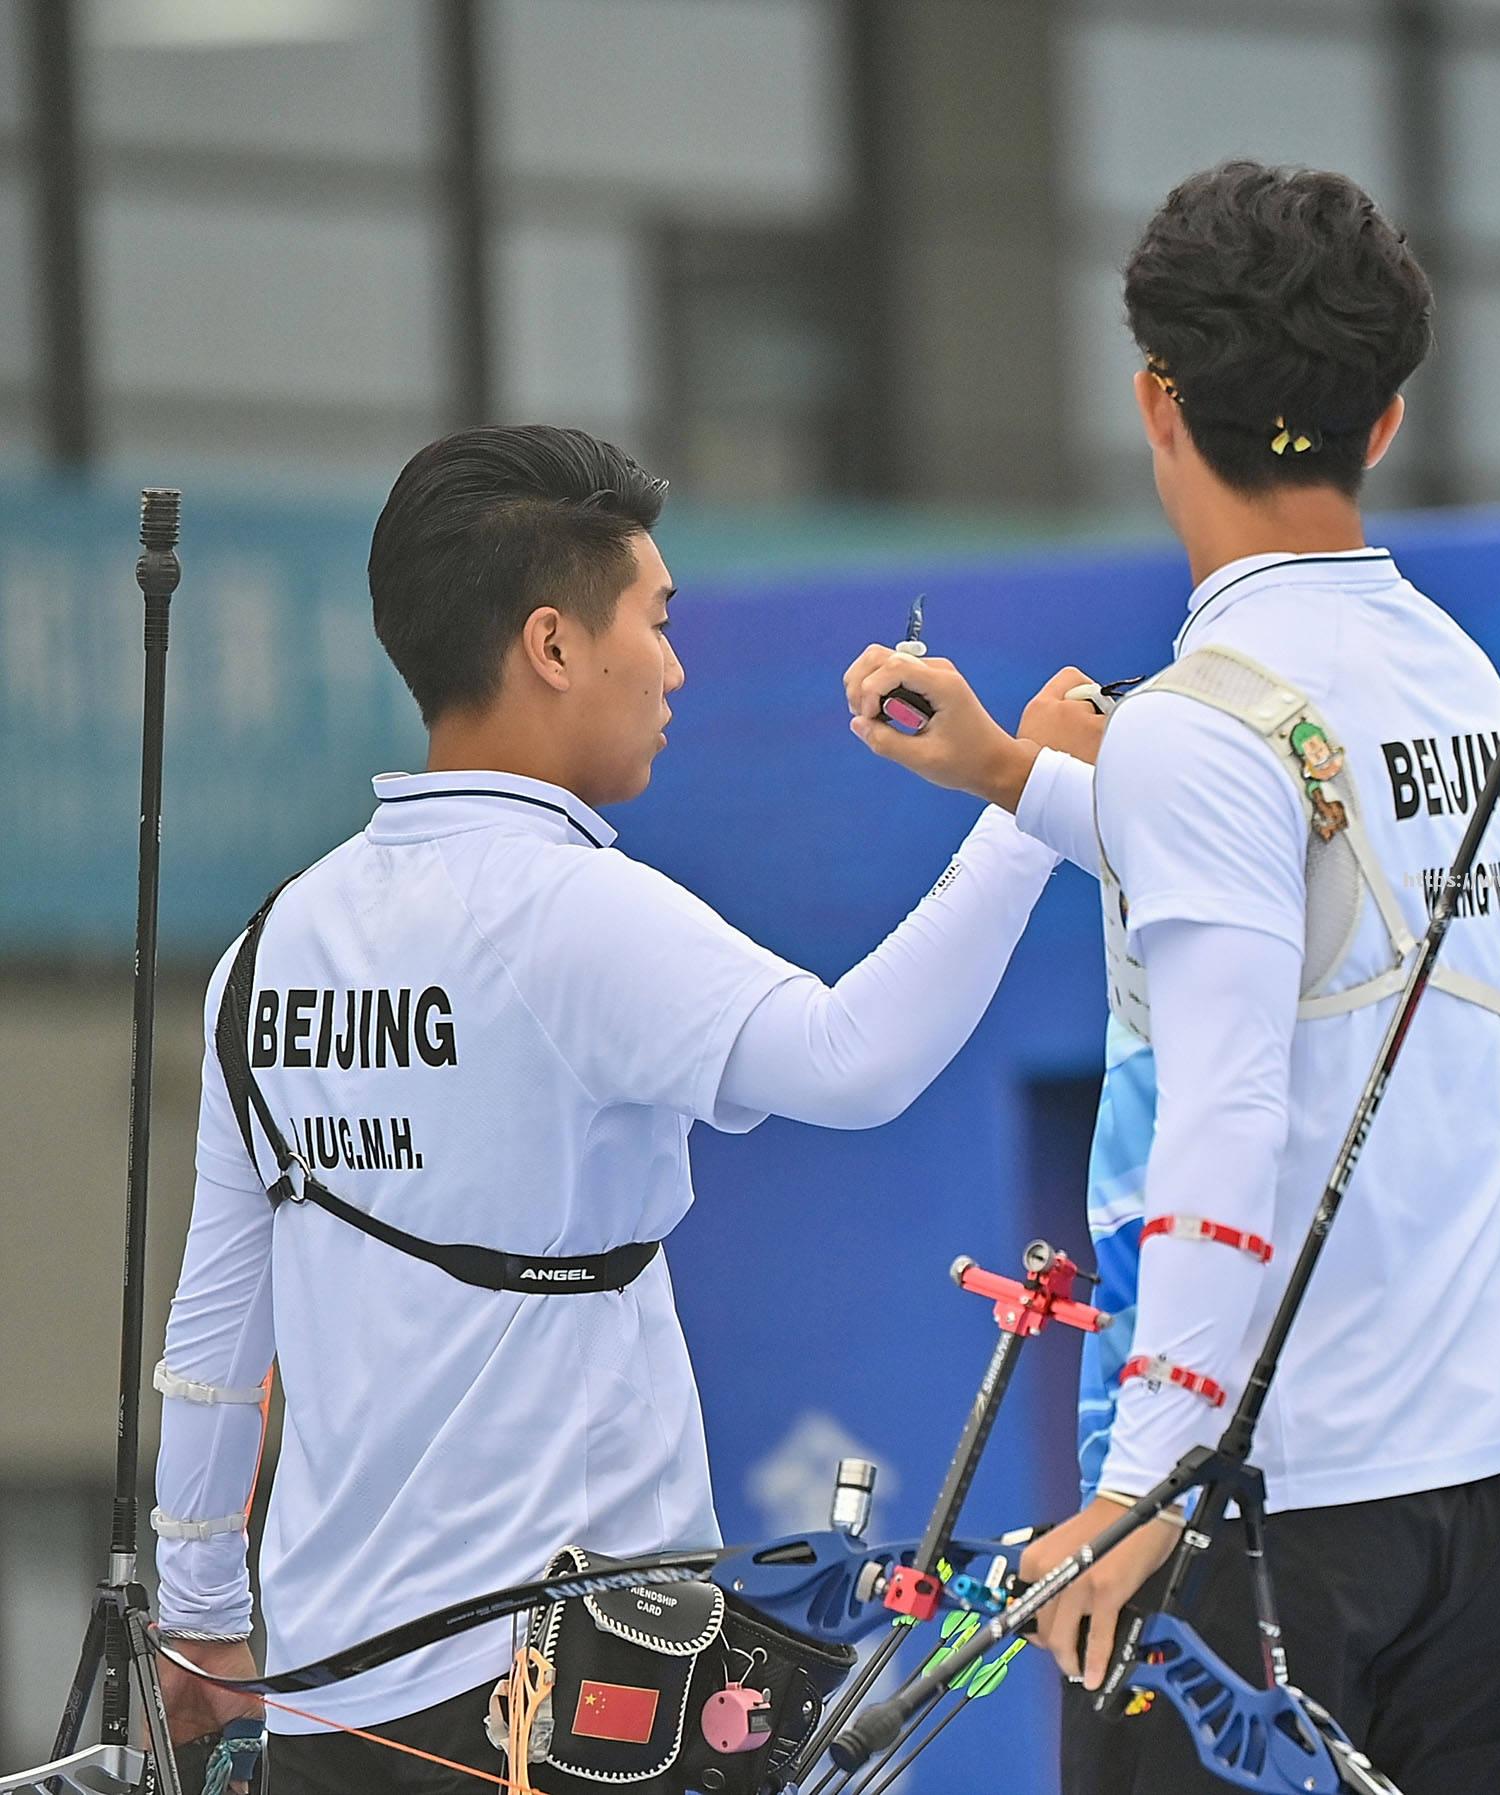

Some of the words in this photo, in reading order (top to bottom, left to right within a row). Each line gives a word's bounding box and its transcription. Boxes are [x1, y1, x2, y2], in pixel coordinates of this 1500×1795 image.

[252, 986, 457, 1069] BEIJING
[519, 1267, 596, 1282] ANGEL
[627, 1586, 678, 1608] RIENDSHIP
[636, 1601, 663, 1617] CARD
